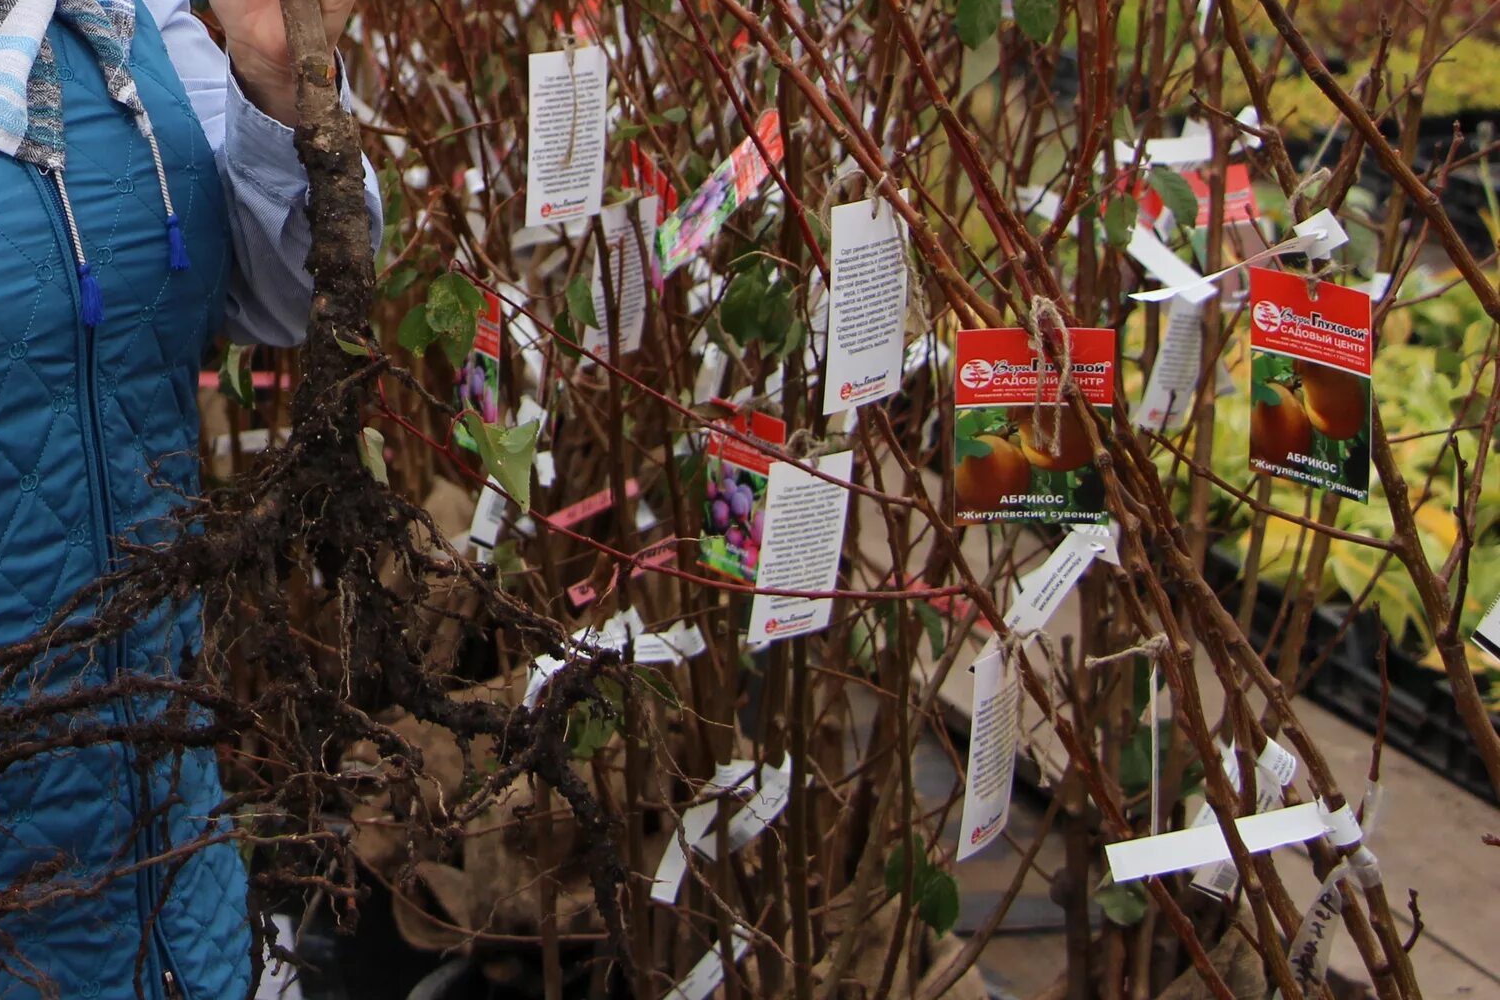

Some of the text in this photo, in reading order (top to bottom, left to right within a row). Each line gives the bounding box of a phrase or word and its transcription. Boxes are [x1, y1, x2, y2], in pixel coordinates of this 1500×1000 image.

[1281, 326, 1332, 345] САДОВЫЙ
[1335, 338, 1364, 353] ЦЕНТР
[1286, 452, 1337, 473] АБРИКОС
[1000, 495, 1064, 504] АБРИКОС
